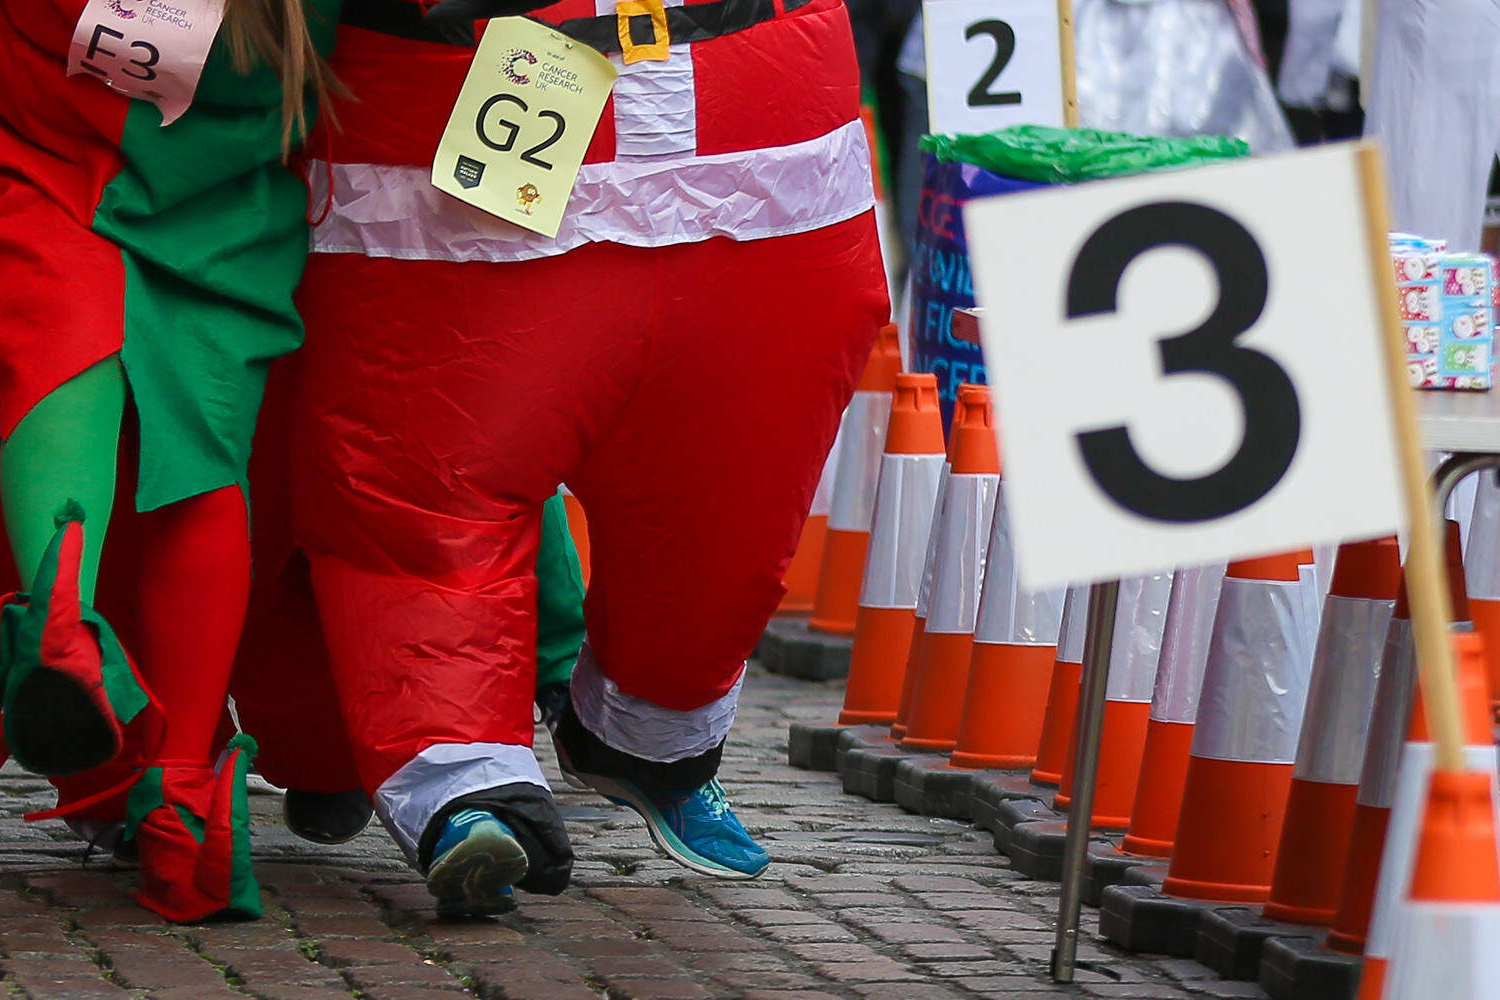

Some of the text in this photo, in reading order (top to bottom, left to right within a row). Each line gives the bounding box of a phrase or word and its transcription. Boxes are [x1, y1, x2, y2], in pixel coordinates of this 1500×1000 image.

[141, 15, 156, 26] UK
[145, 7, 193, 31] RESEARCH
[149, 0, 188, 19] CANCER
[541, 62, 579, 81] CANCER
[965, 19, 1023, 107] 2
[534, 81, 548, 92] UK
[538, 72, 584, 95] RESEARCH
[476, 93, 566, 171] G2
[1065, 201, 1301, 524] 3
